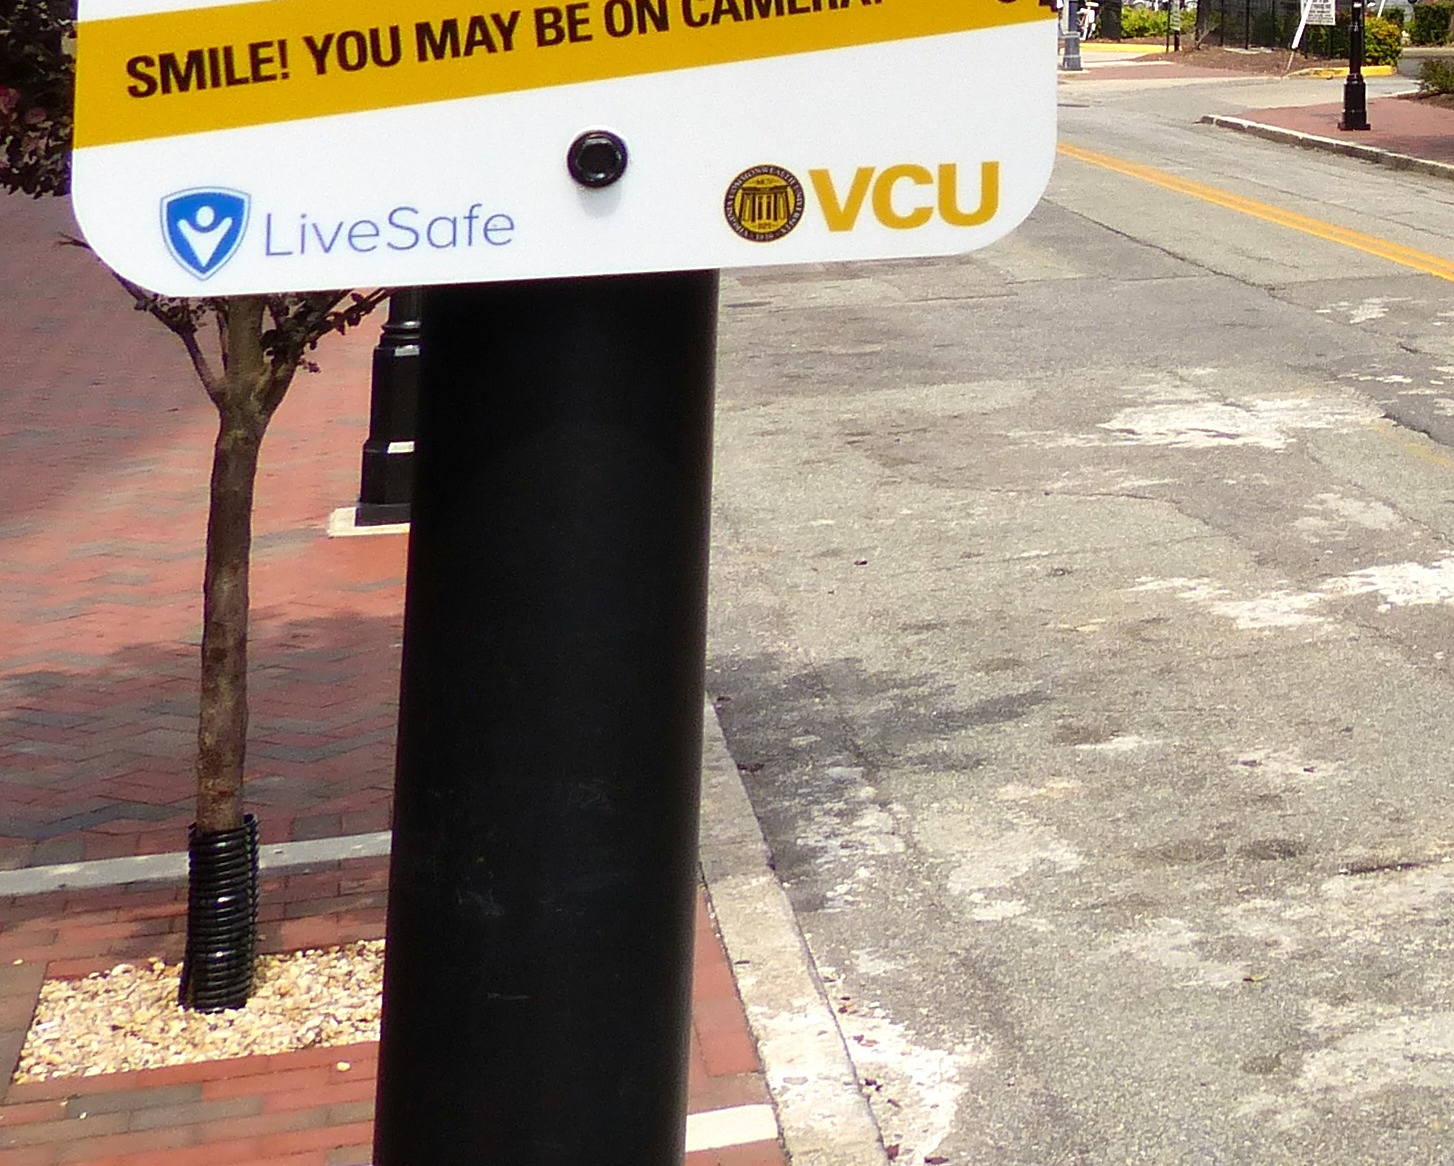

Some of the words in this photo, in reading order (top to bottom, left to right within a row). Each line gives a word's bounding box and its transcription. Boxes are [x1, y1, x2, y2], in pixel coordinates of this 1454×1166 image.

[126, 39, 288, 98] SMILE!
[303, 25, 402, 75] YOU
[415, 10, 521, 62] MAY
[534, 2, 593, 47] BE
[264, 202, 516, 257] LiveSafe
[808, 160, 1001, 234] VCU
